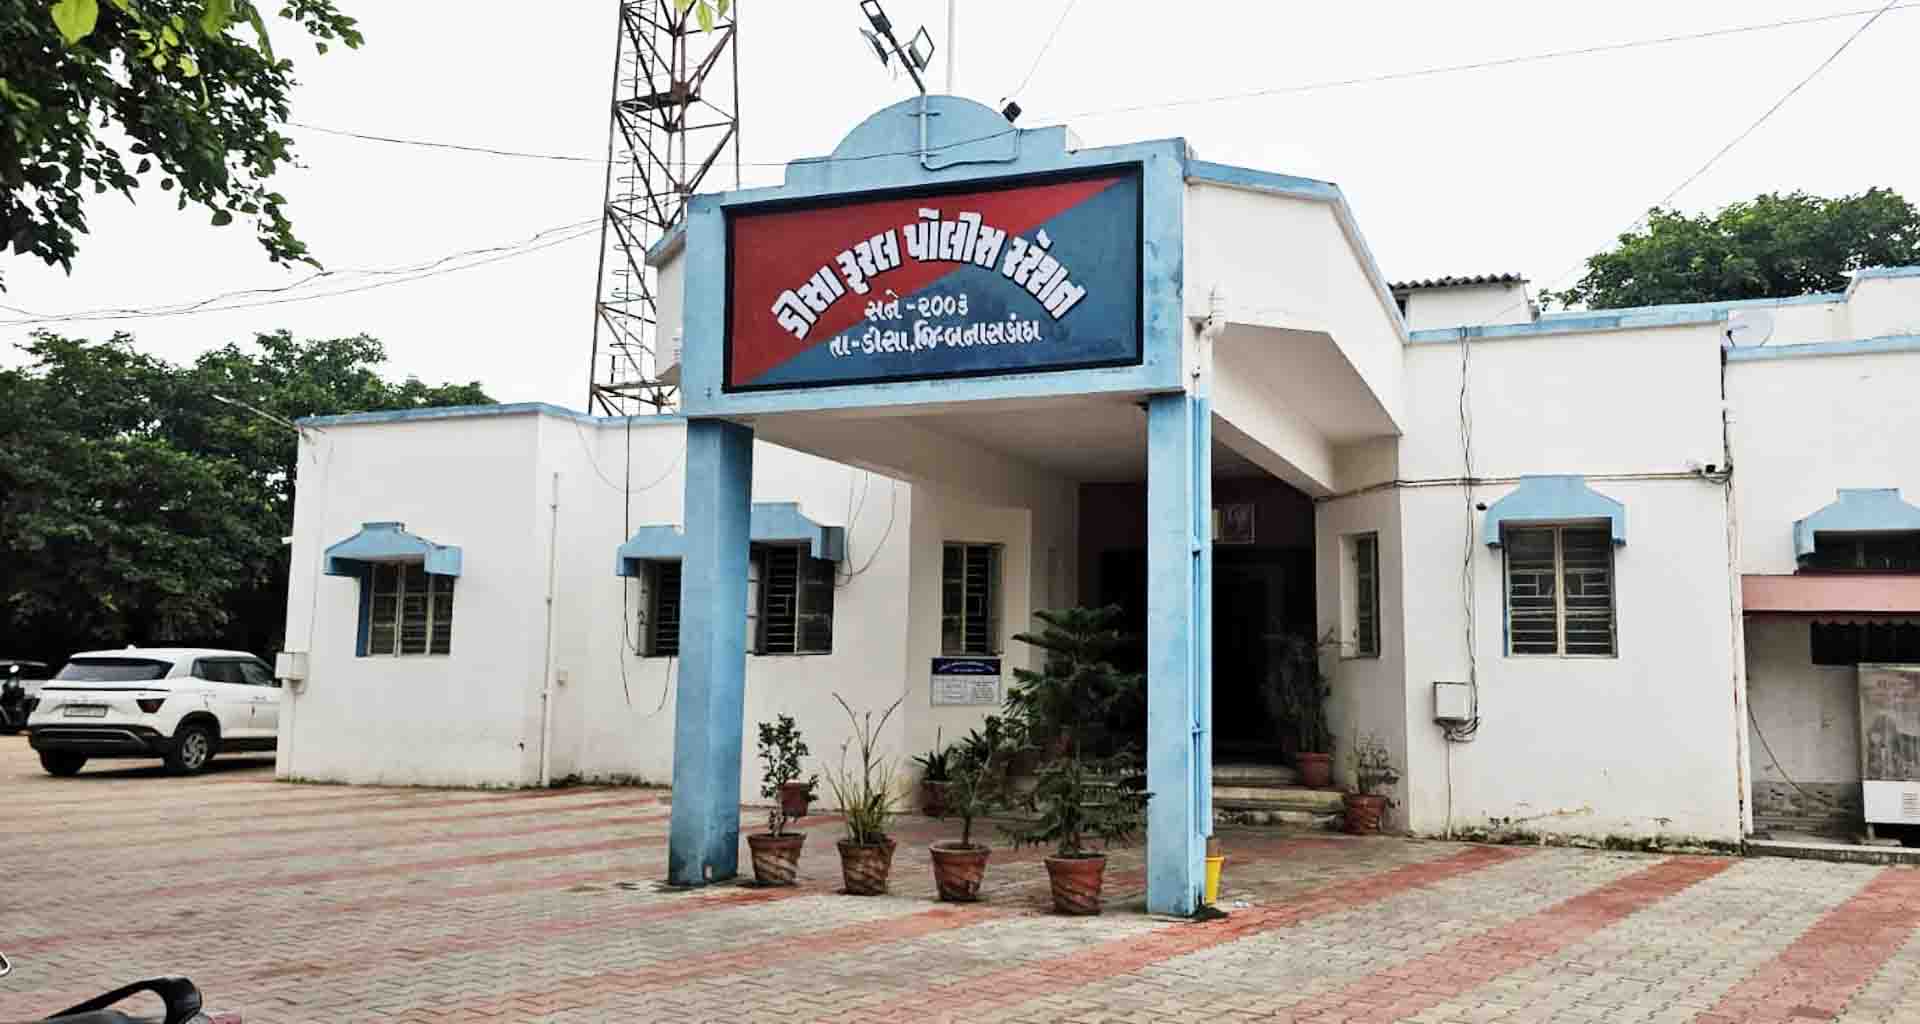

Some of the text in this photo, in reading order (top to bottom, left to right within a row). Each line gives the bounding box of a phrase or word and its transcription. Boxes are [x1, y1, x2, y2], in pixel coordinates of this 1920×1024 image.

[771, 208, 1087, 340] ડીસા રૂરલ પોલીસ સ્ટેશન
